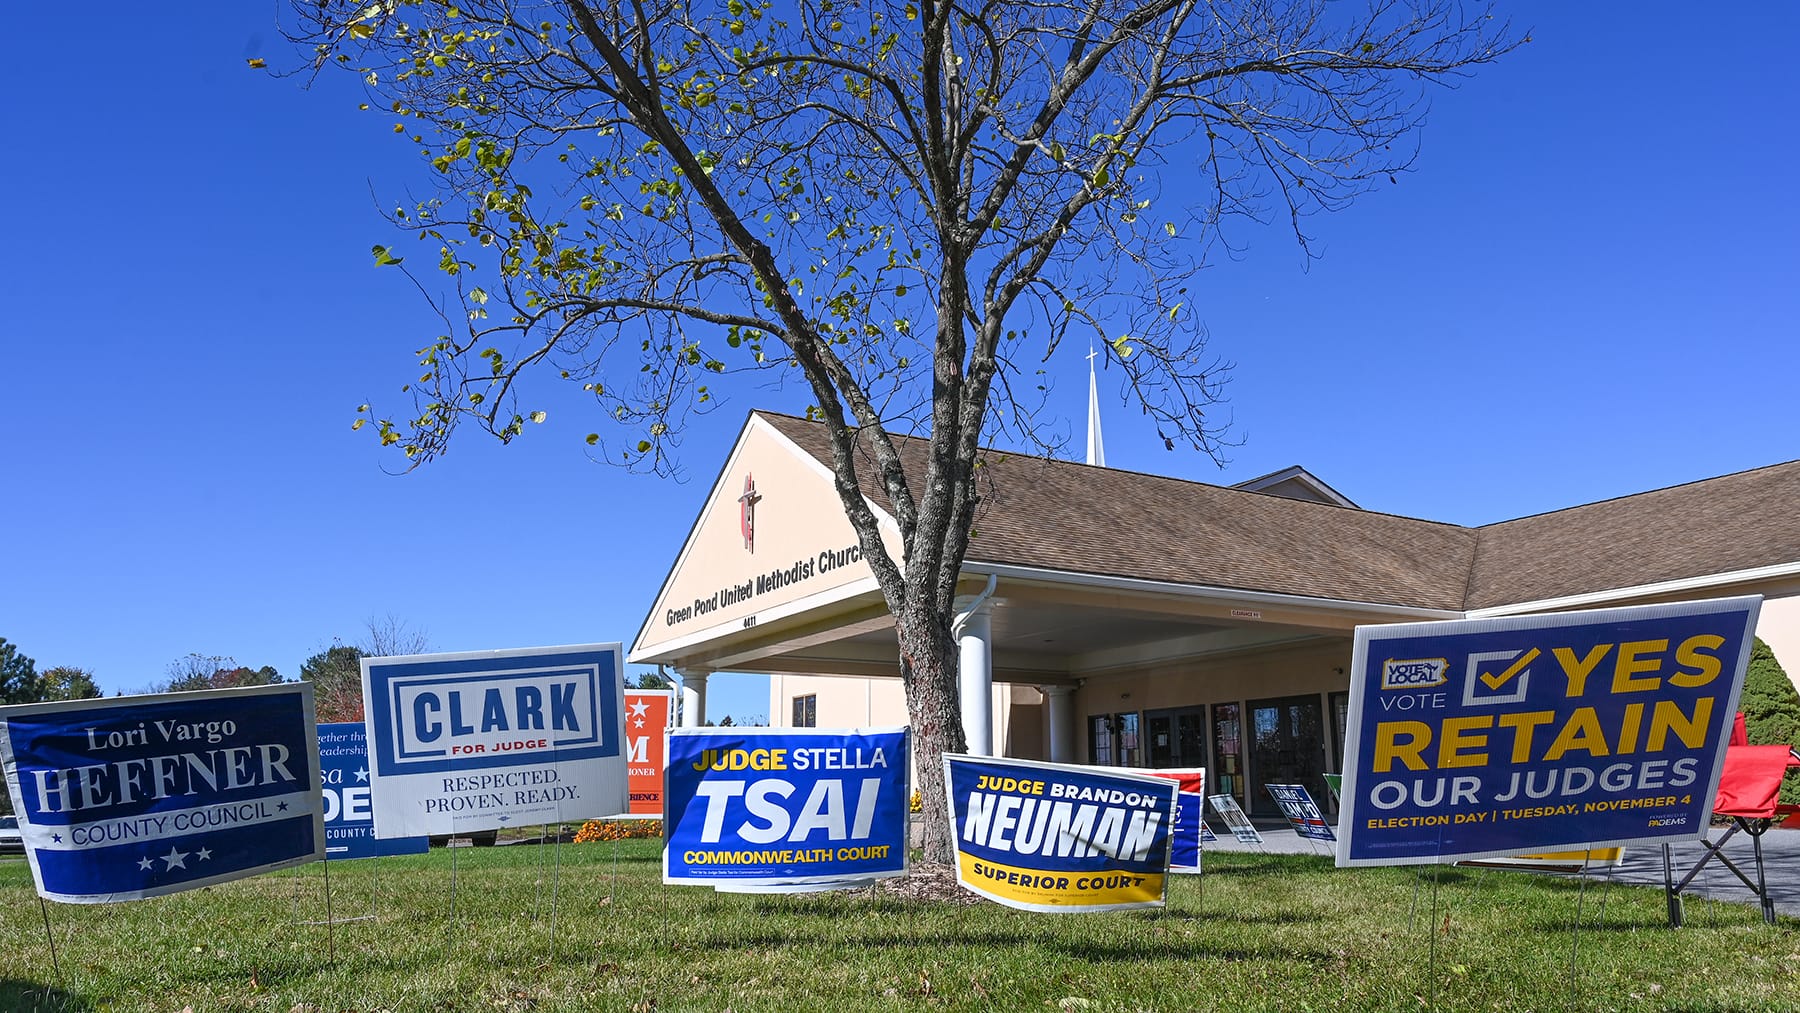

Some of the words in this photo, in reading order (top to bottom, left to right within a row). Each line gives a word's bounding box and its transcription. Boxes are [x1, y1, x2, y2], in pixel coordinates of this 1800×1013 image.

[666, 606, 692, 627] Green
[694, 592, 718, 617] Pond
[720, 579, 753, 608] United
[756, 557, 814, 596] Methodist
[1388, 664, 1425, 675] VOTE
[1388, 671, 1438, 685] LOCAL
[1551, 634, 1727, 699] YES
[413, 683, 580, 743] CLARK
[1380, 692, 1447, 711] VOTE
[86, 722, 149, 751] Lori
[154, 718, 237, 743] Vargo
[452, 744, 486, 755] FOR
[491, 739, 547, 752] JUDGE
[1372, 697, 1715, 773] RETAIN
[692, 749, 788, 771] JUDGE
[792, 747, 887, 771] STELLA
[30, 743, 297, 814] HEFFNER
[442, 769, 561, 793] RESPECTED.
[976, 775, 1045, 796] JUDGE
[1049, 783, 1157, 809] BRANDON
[1370, 776, 1482, 810] OUR
[1494, 757, 1699, 802] JUDGES
[426, 796, 508, 814] PROVEN.
[515, 785, 580, 806] READY.
[695, 777, 881, 844] TSAI
[1367, 815, 1449, 829] ELECTION
[1454, 811, 1487, 825] DAY
[1502, 804, 1580, 820] TUESDAY,
[1584, 796, 1676, 813] NOVEMBER
[1680, 794, 1692, 805] 4
[72, 816, 167, 846] COUNTY
[174, 801, 272, 831] COUNCIL
[326, 827, 366, 839] COUNTY
[963, 791, 1162, 861] NEUMAN
[683, 850, 833, 865] COMMONWEALTH
[836, 845, 890, 861] COURT
[973, 862, 1068, 890] SUPERIOR
[1075, 877, 1146, 892] COURT
